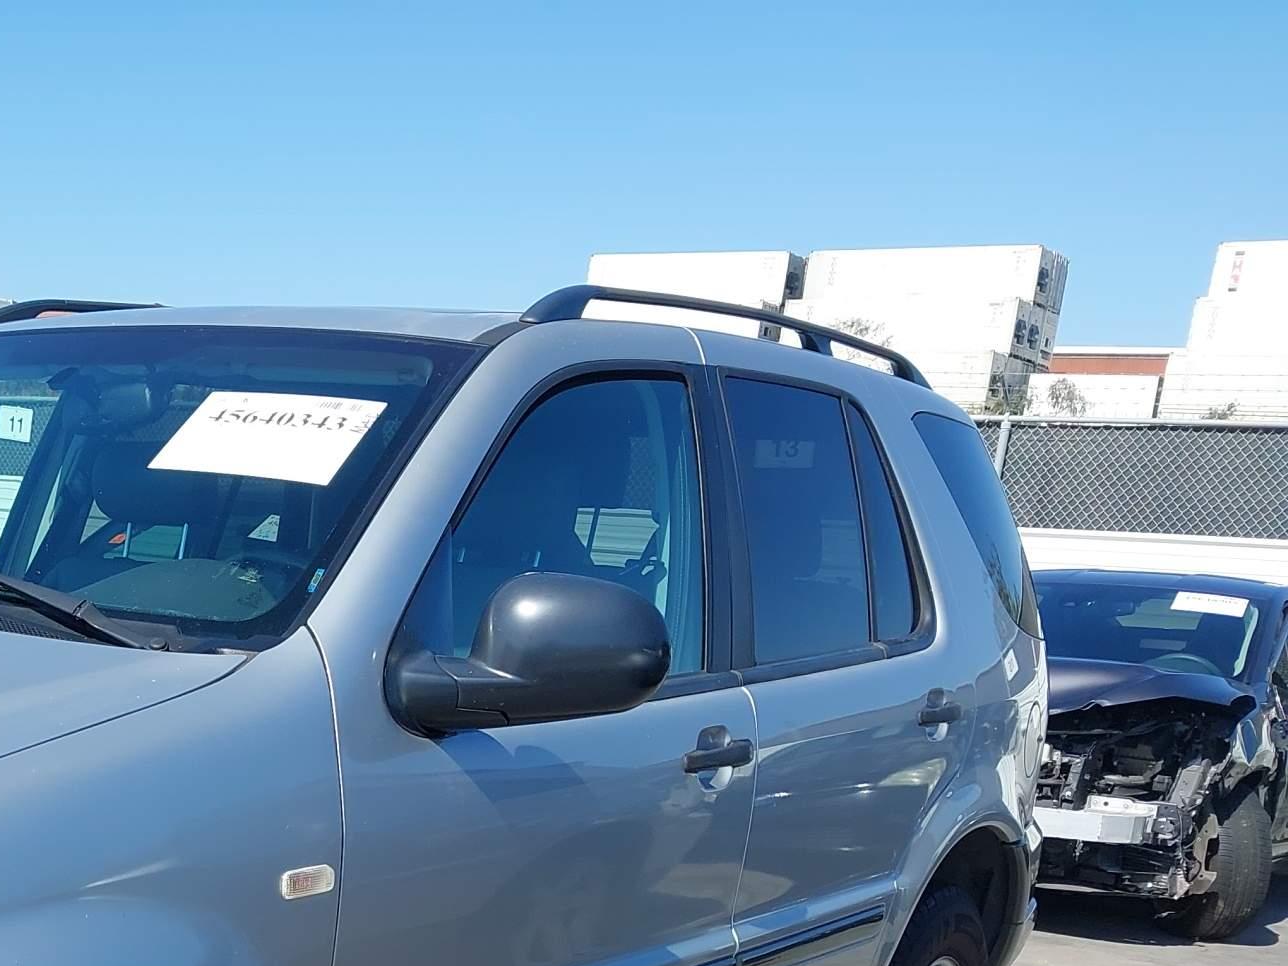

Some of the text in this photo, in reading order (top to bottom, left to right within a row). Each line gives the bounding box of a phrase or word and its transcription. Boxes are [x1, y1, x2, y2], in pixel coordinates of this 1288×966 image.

[9, 415, 23, 433] 11
[209, 409, 347, 431] 45640343
[772, 440, 800, 458] 13
